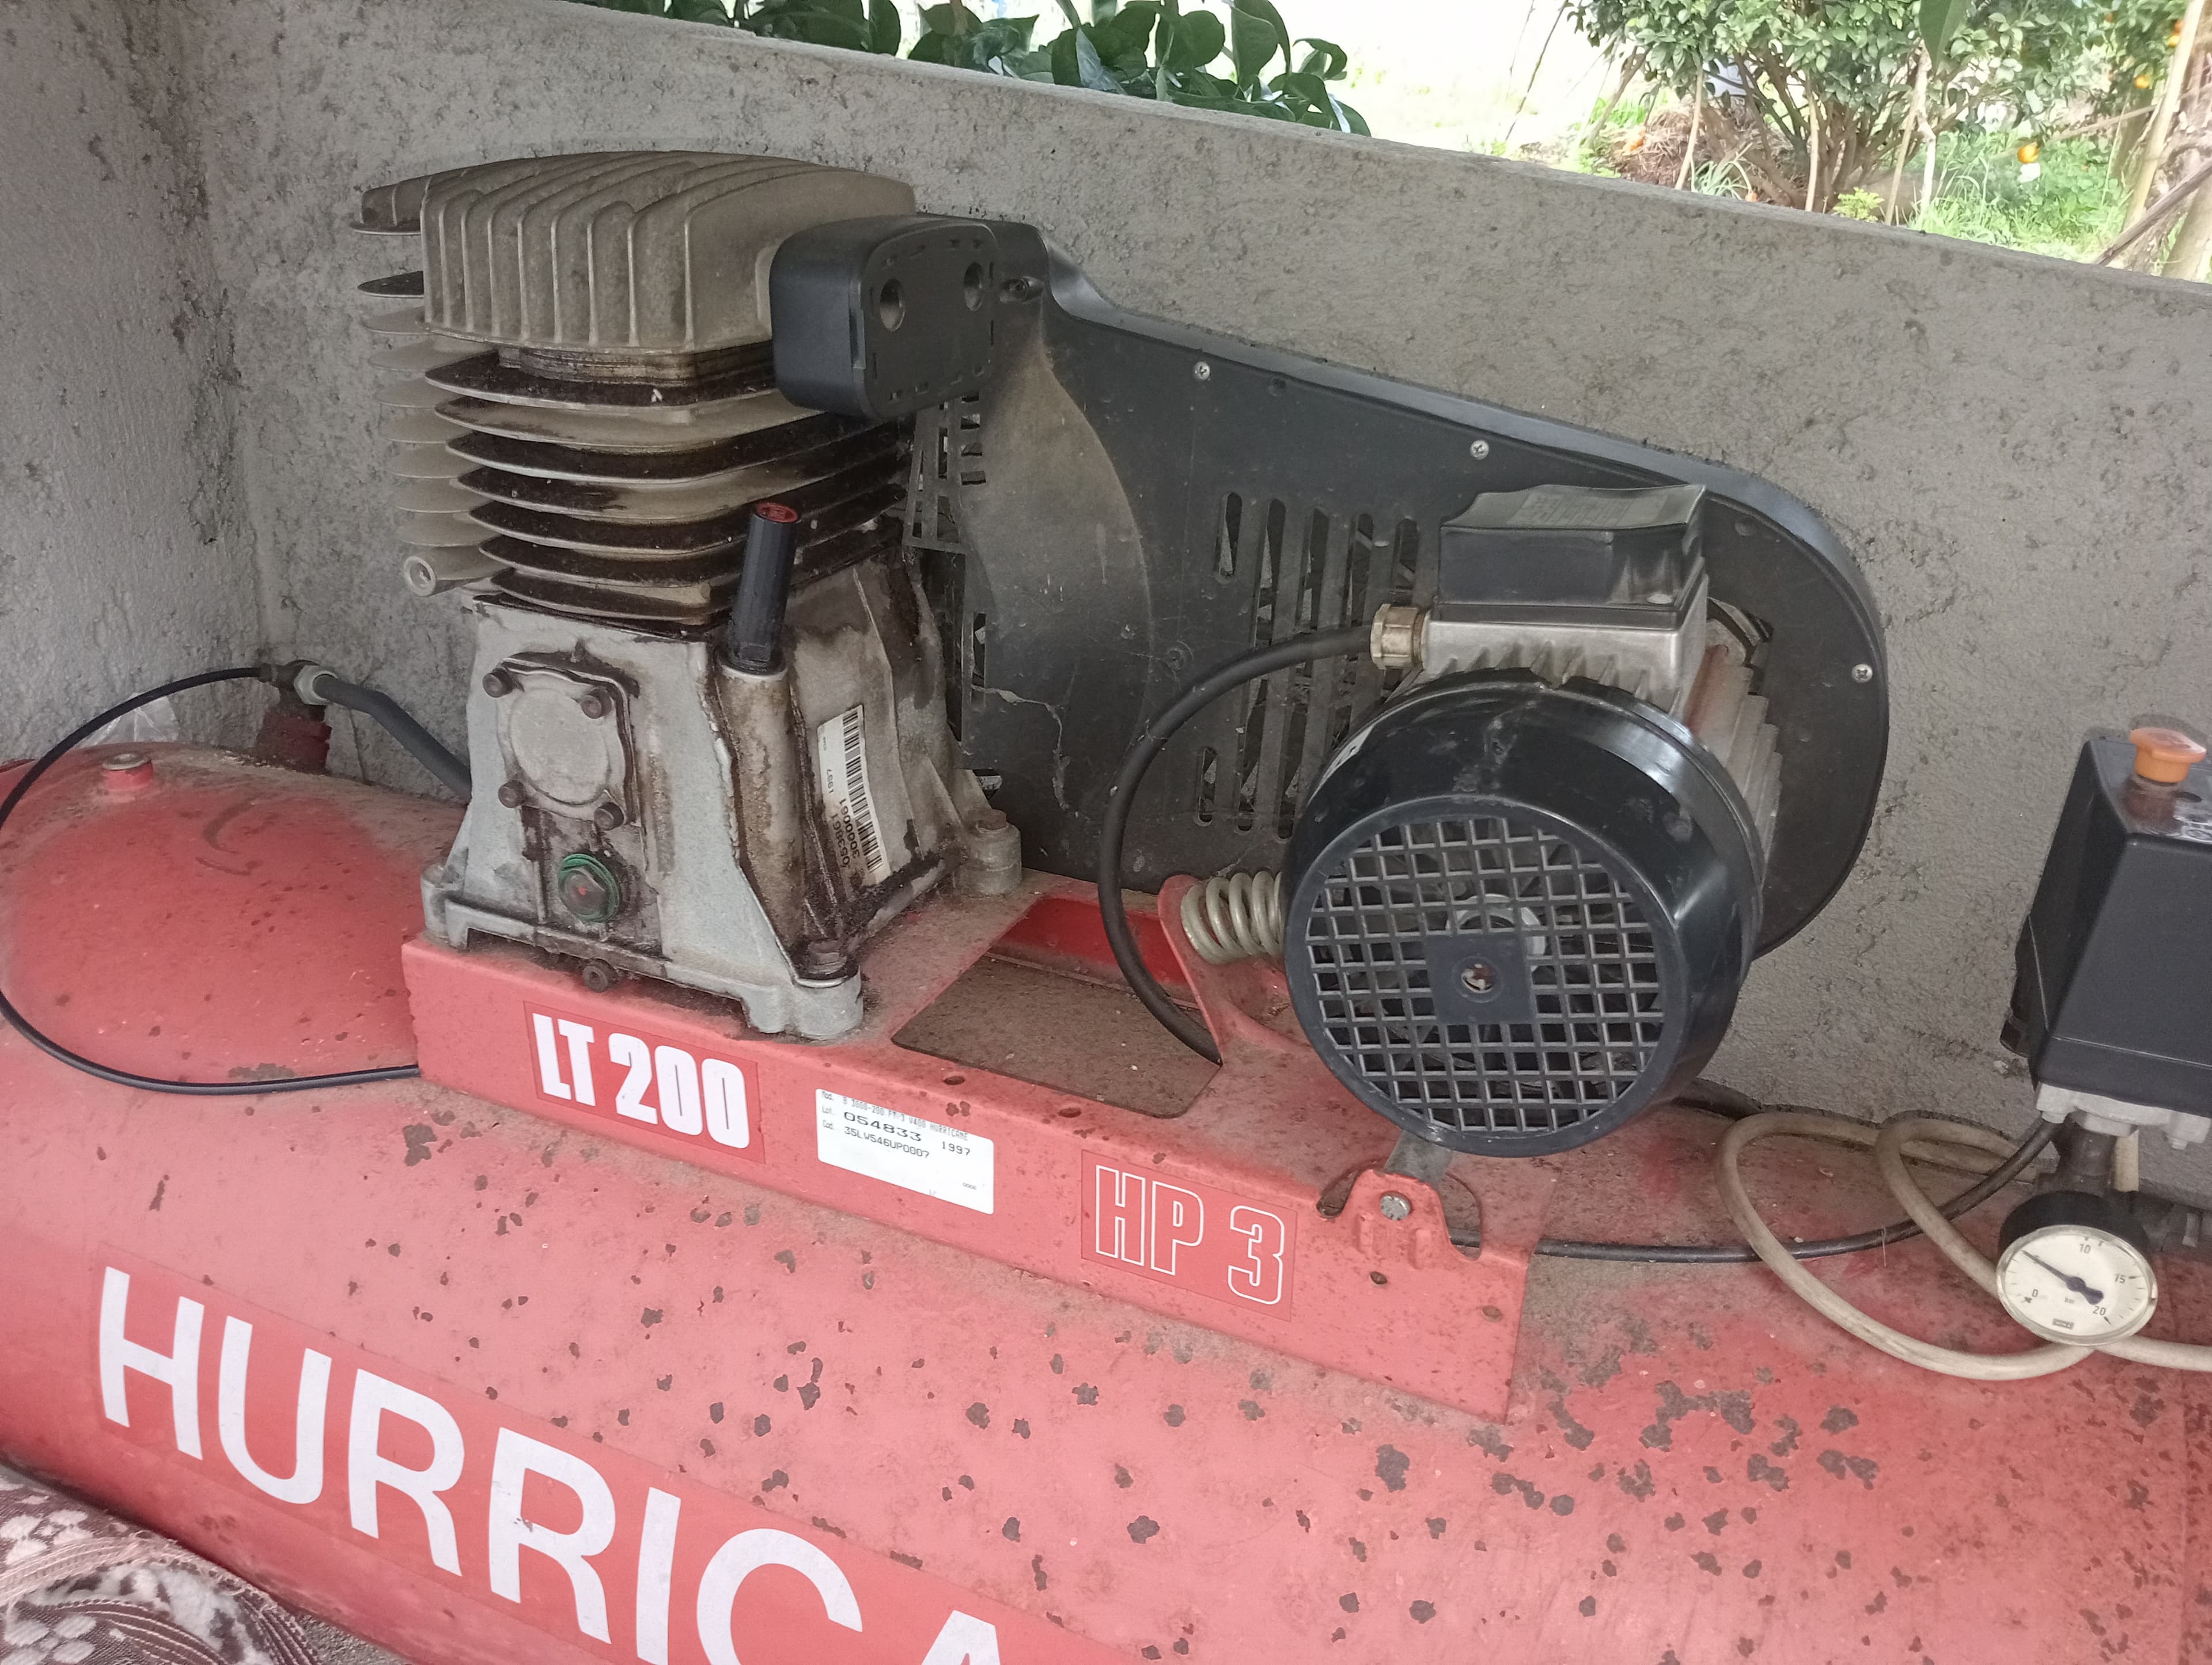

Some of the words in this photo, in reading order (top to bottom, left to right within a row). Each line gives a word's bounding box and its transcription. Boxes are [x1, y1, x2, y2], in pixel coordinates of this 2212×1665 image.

[532, 1012, 596, 1106] LT
[608, 1033, 749, 1148] 200
[843, 1112, 922, 1141] 054833
[941, 1141, 971, 1156] 1997
[930, 1123, 969, 1141] HURRICANE
[1096, 1165, 1204, 1276] HP
[1228, 1205, 1285, 1304] 3
[2079, 1243, 2091, 1254] 10
[2115, 1273, 2126, 1284] 15
[2032, 1289, 2039, 1298] 0
[2092, 1305, 2107, 1317] 20
